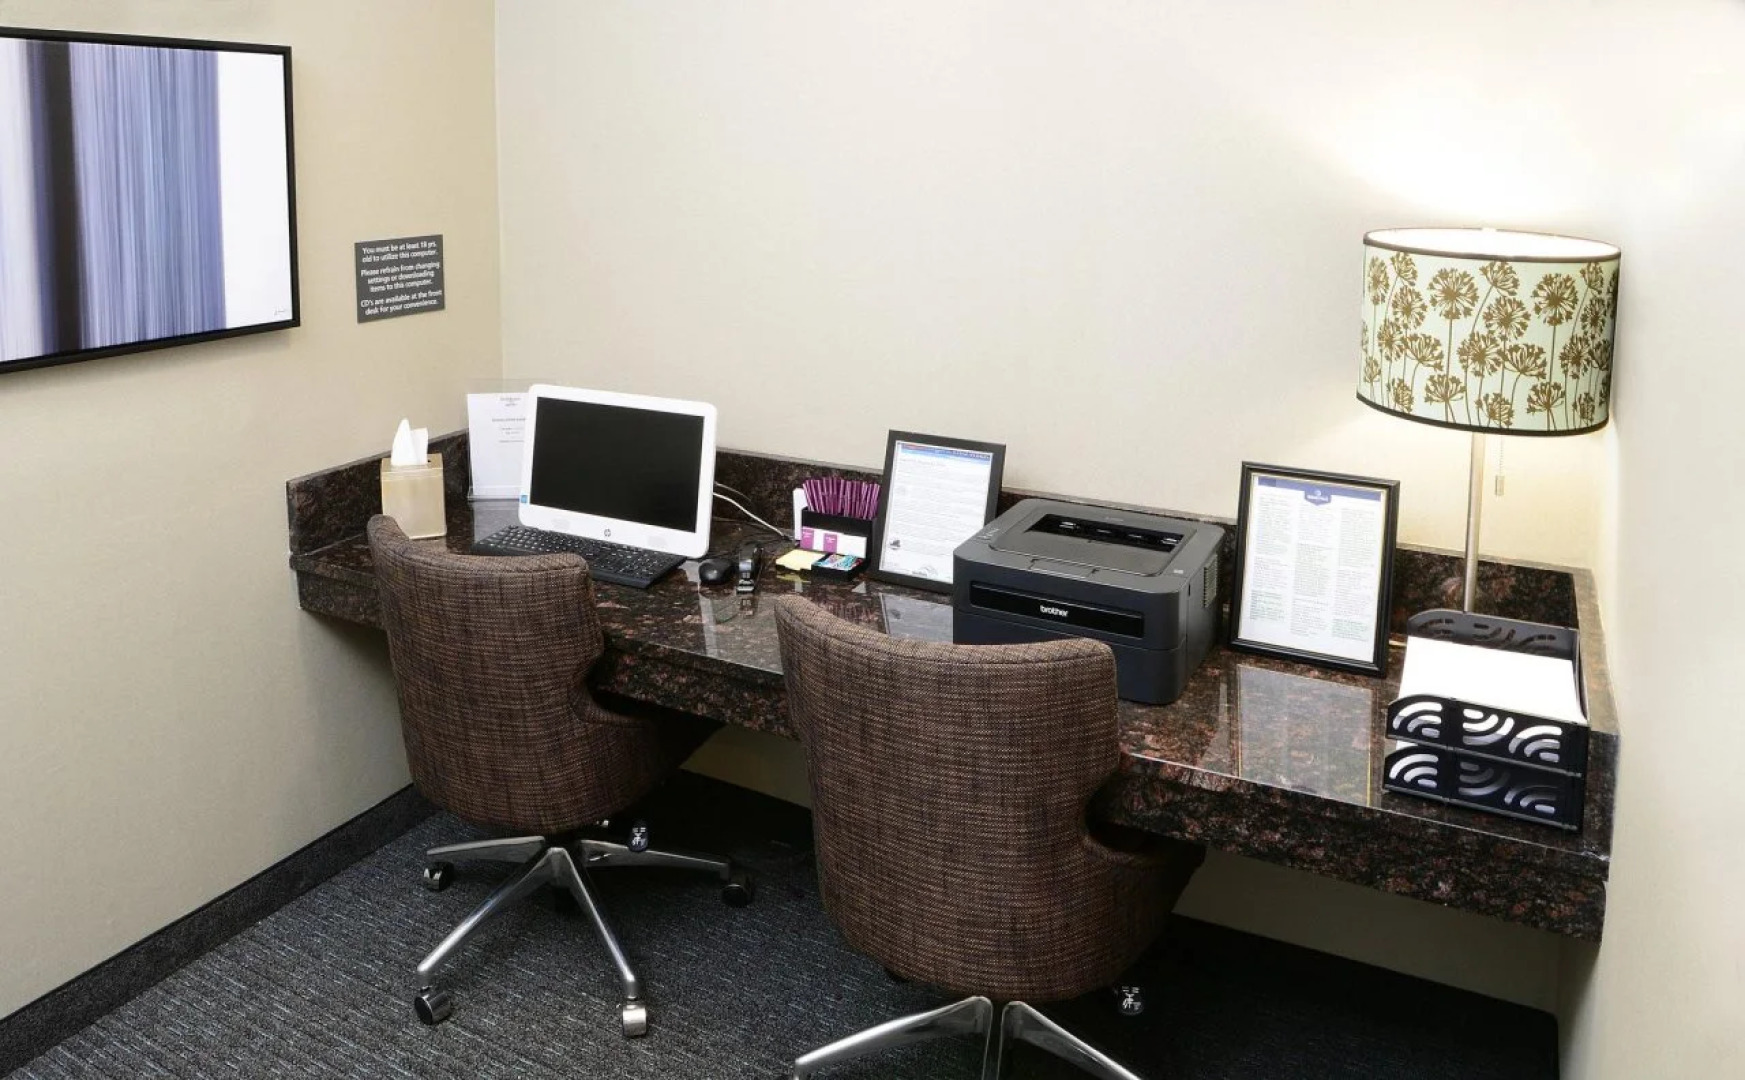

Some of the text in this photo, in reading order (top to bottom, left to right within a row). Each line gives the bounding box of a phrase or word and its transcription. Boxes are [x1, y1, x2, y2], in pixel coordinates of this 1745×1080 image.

[398, 270, 434, 280] downloading
[386, 294, 410, 303] available
[365, 307, 378, 315] desk
[390, 304, 402, 312] your
[1040, 604, 1068, 617] brother
